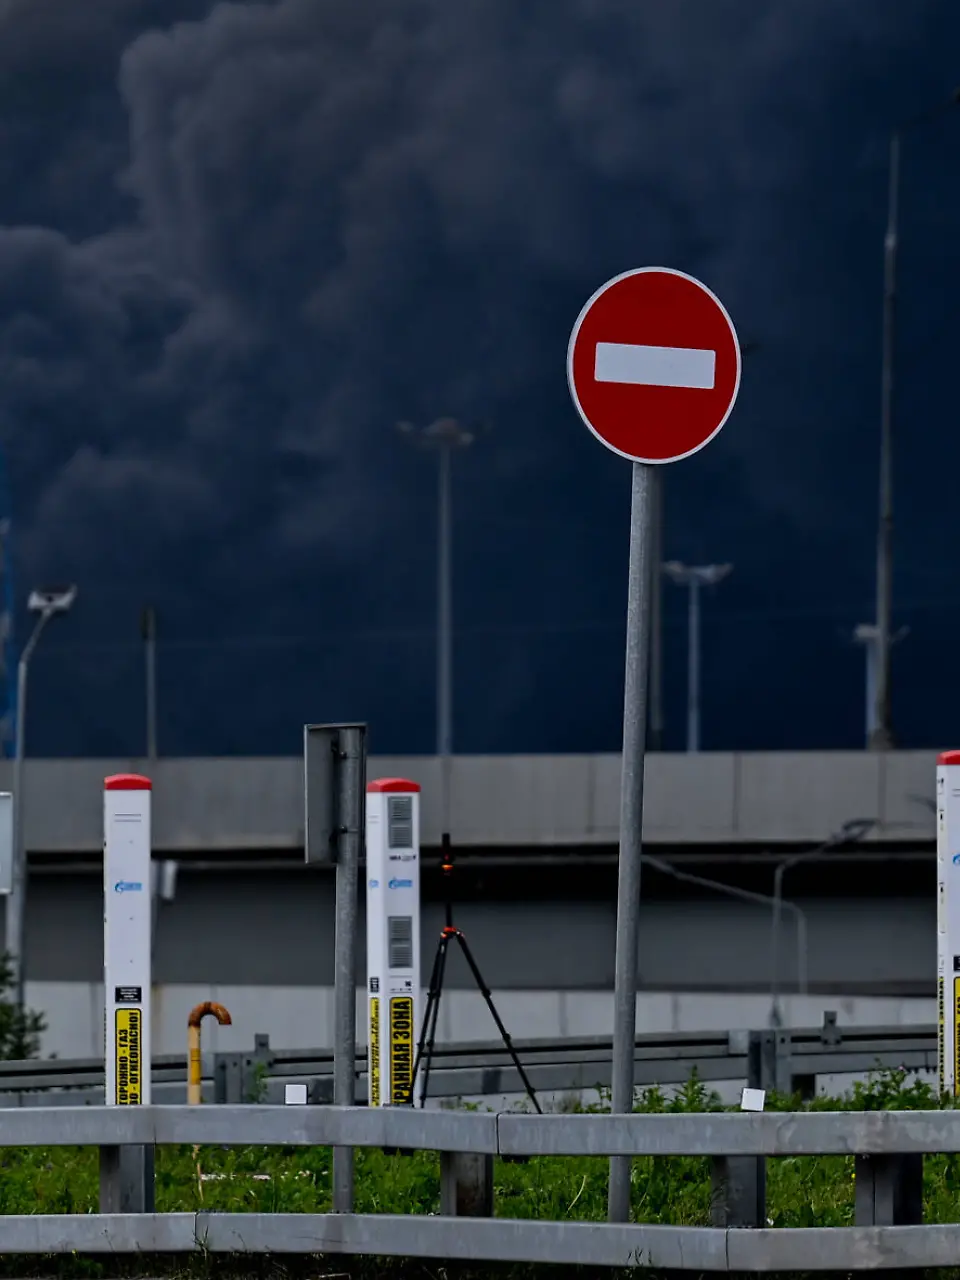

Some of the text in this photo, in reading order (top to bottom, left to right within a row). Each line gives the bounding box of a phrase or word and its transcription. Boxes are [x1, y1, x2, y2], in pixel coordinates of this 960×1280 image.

[119, 1029, 128, 1048] ГАЗ
[393, 1001, 410, 1040] ЗОНА
[129, 1012, 138, 1084] ОГНЕОПАСНО!
[393, 1043, 410, 1103] РАННАЯ
